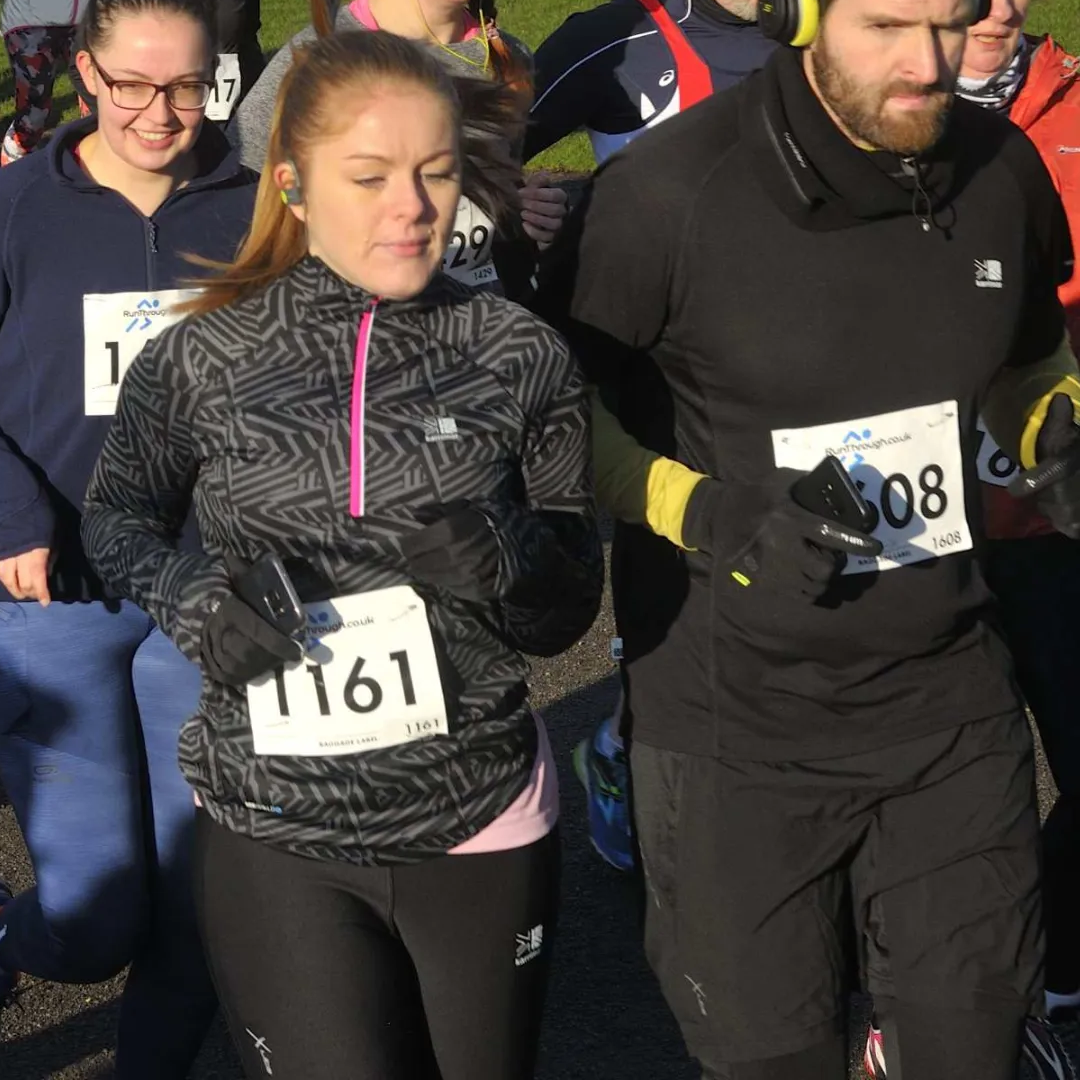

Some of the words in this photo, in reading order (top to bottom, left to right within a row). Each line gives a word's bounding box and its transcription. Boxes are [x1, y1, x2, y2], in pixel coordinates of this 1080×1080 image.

[214, 78, 236, 103] 17
[443, 225, 489, 270] 29
[856, 463, 948, 534] 08
[931, 530, 963, 550] 1608
[274, 649, 418, 717] 1161
[405, 718, 440, 734] 1161
